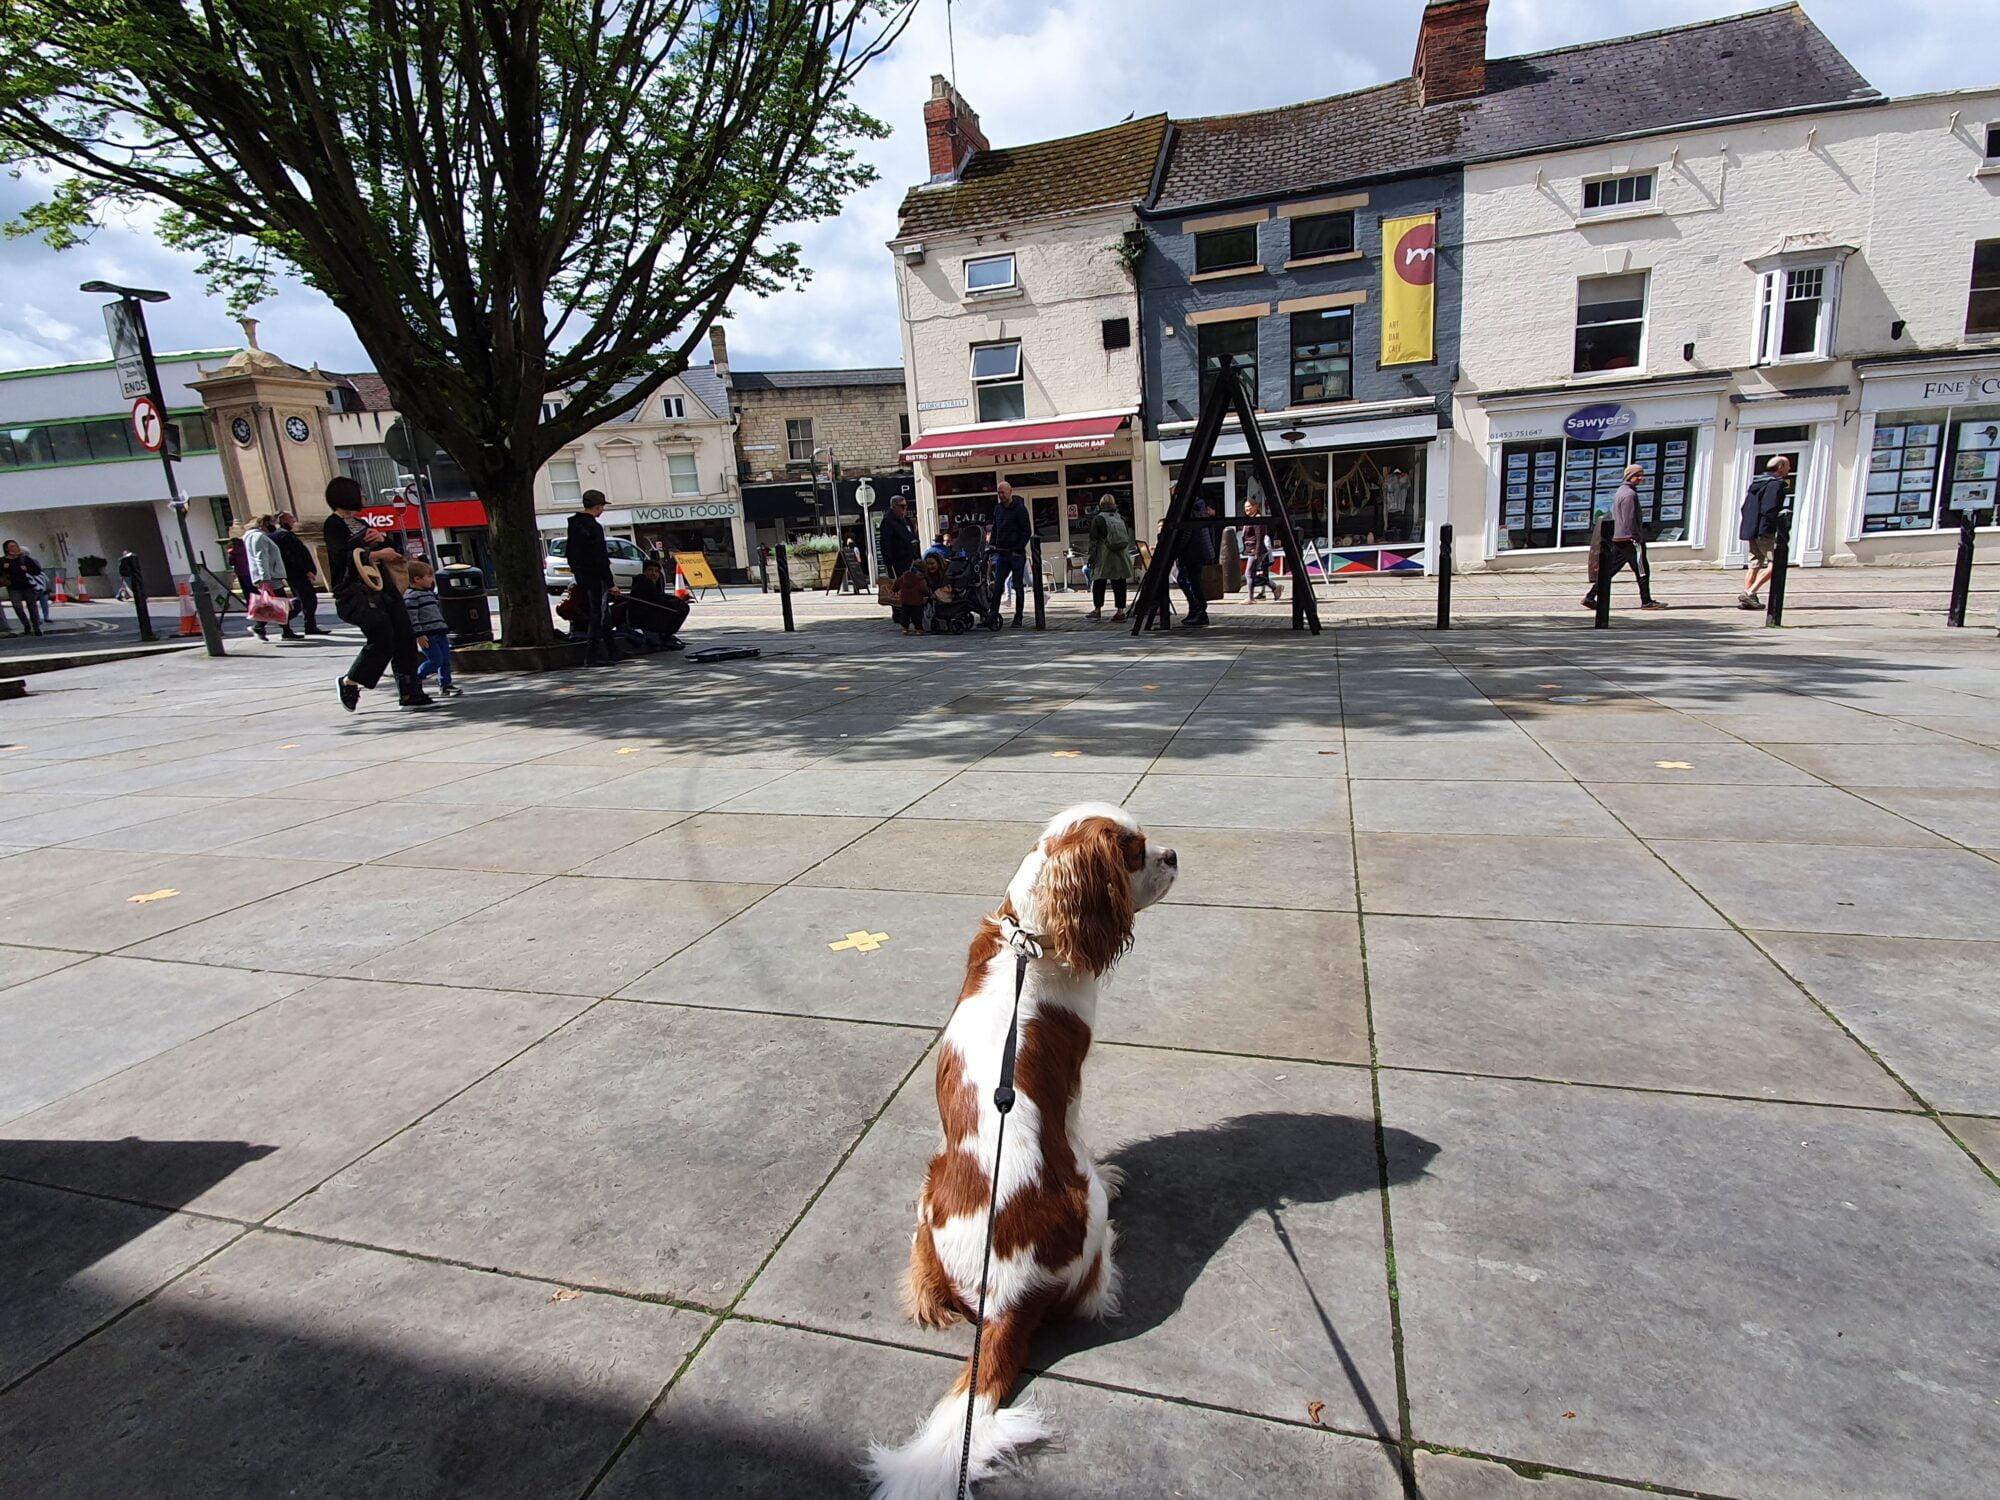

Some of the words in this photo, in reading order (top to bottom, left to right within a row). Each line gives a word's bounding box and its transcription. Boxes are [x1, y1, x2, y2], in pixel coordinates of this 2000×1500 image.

[1388, 320, 1399, 330] ART
[1388, 332, 1400, 341] BAR
[124, 381, 146, 393] ENDS
[1923, 382, 1965, 399] FINE
[919, 403, 943, 411] GEORGE
[944, 400, 966, 409] STREET
[1489, 430, 1514, 440] 01453
[1515, 429, 1543, 437] 751647
[1054, 441, 1090, 450] SANDWICH
[1090, 439, 1105, 447] BAR
[932, 450, 973, 459] RESTAURANT
[636, 507, 684, 520] WORLD
[689, 503, 735, 517] FOODS
